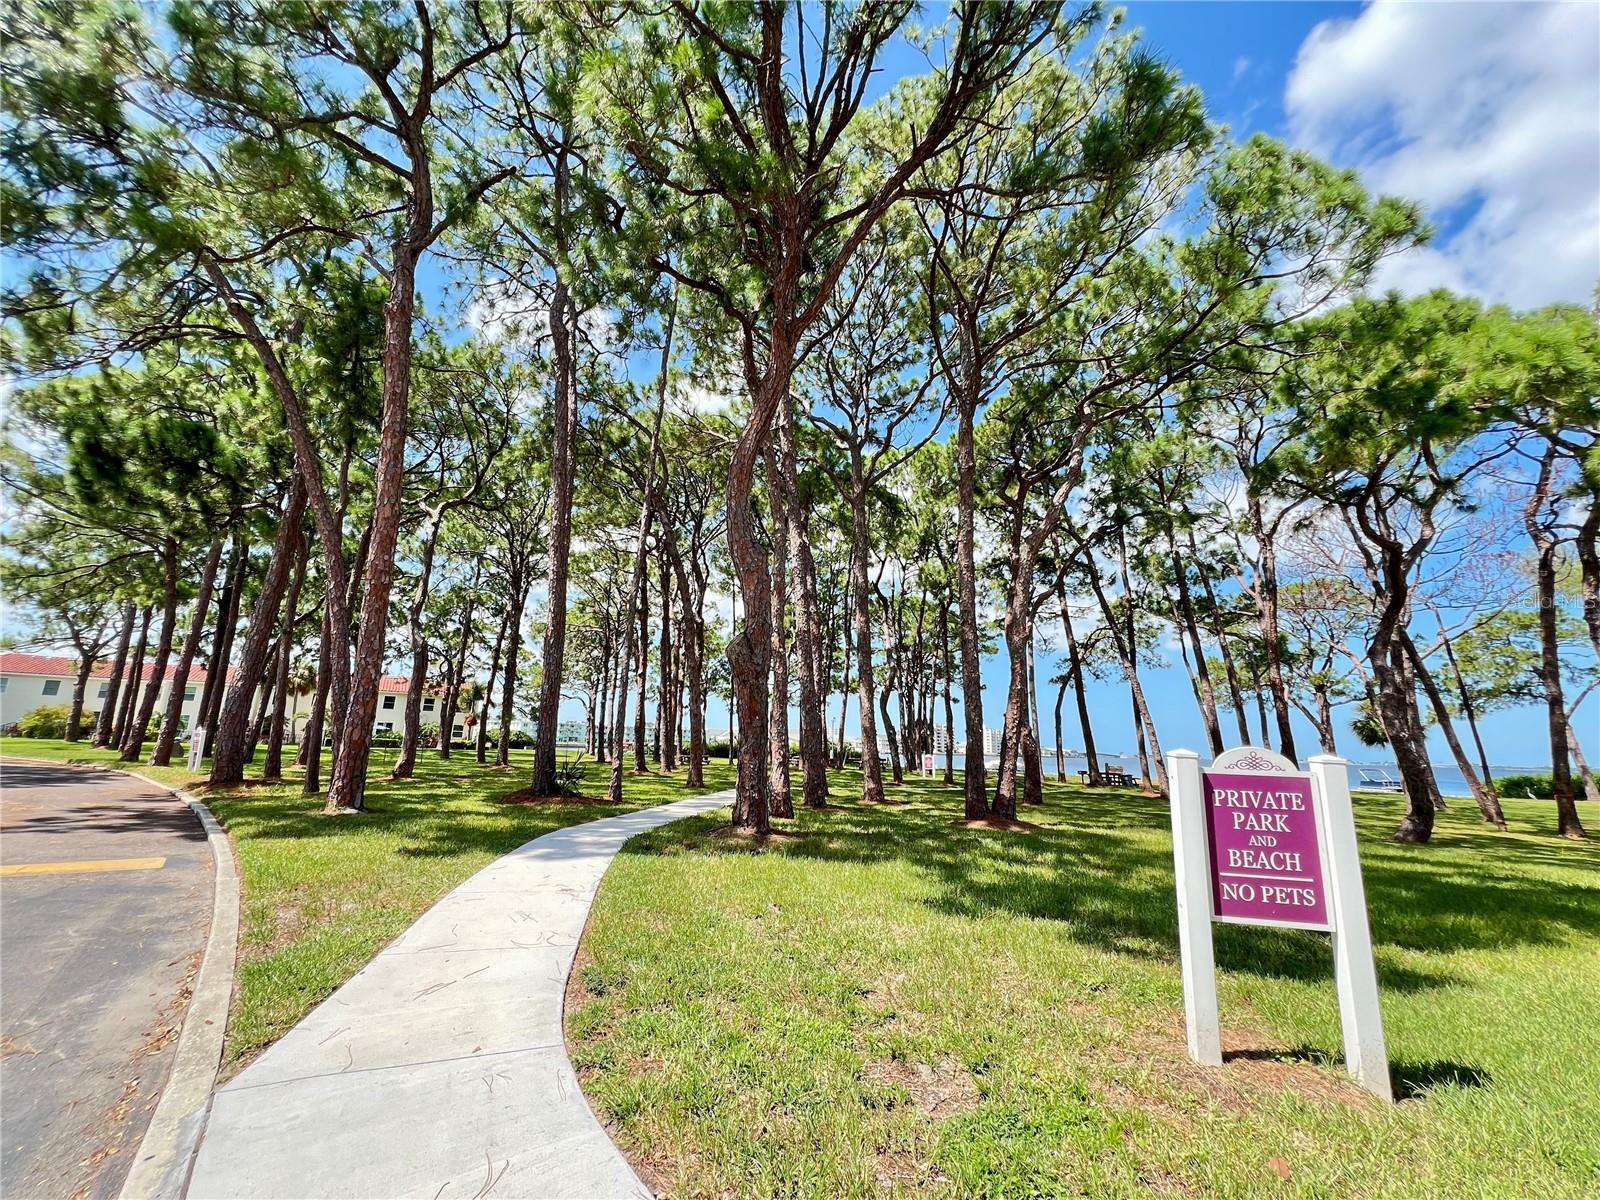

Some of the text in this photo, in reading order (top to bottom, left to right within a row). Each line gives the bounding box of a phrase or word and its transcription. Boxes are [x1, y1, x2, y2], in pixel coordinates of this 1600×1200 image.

[1213, 789, 1305, 811] PRIVATE
[1232, 812, 1291, 832] PARK
[1248, 836, 1277, 848] AND
[1228, 849, 1302, 871] BEACH
[1221, 883, 1316, 907] NO PETS
